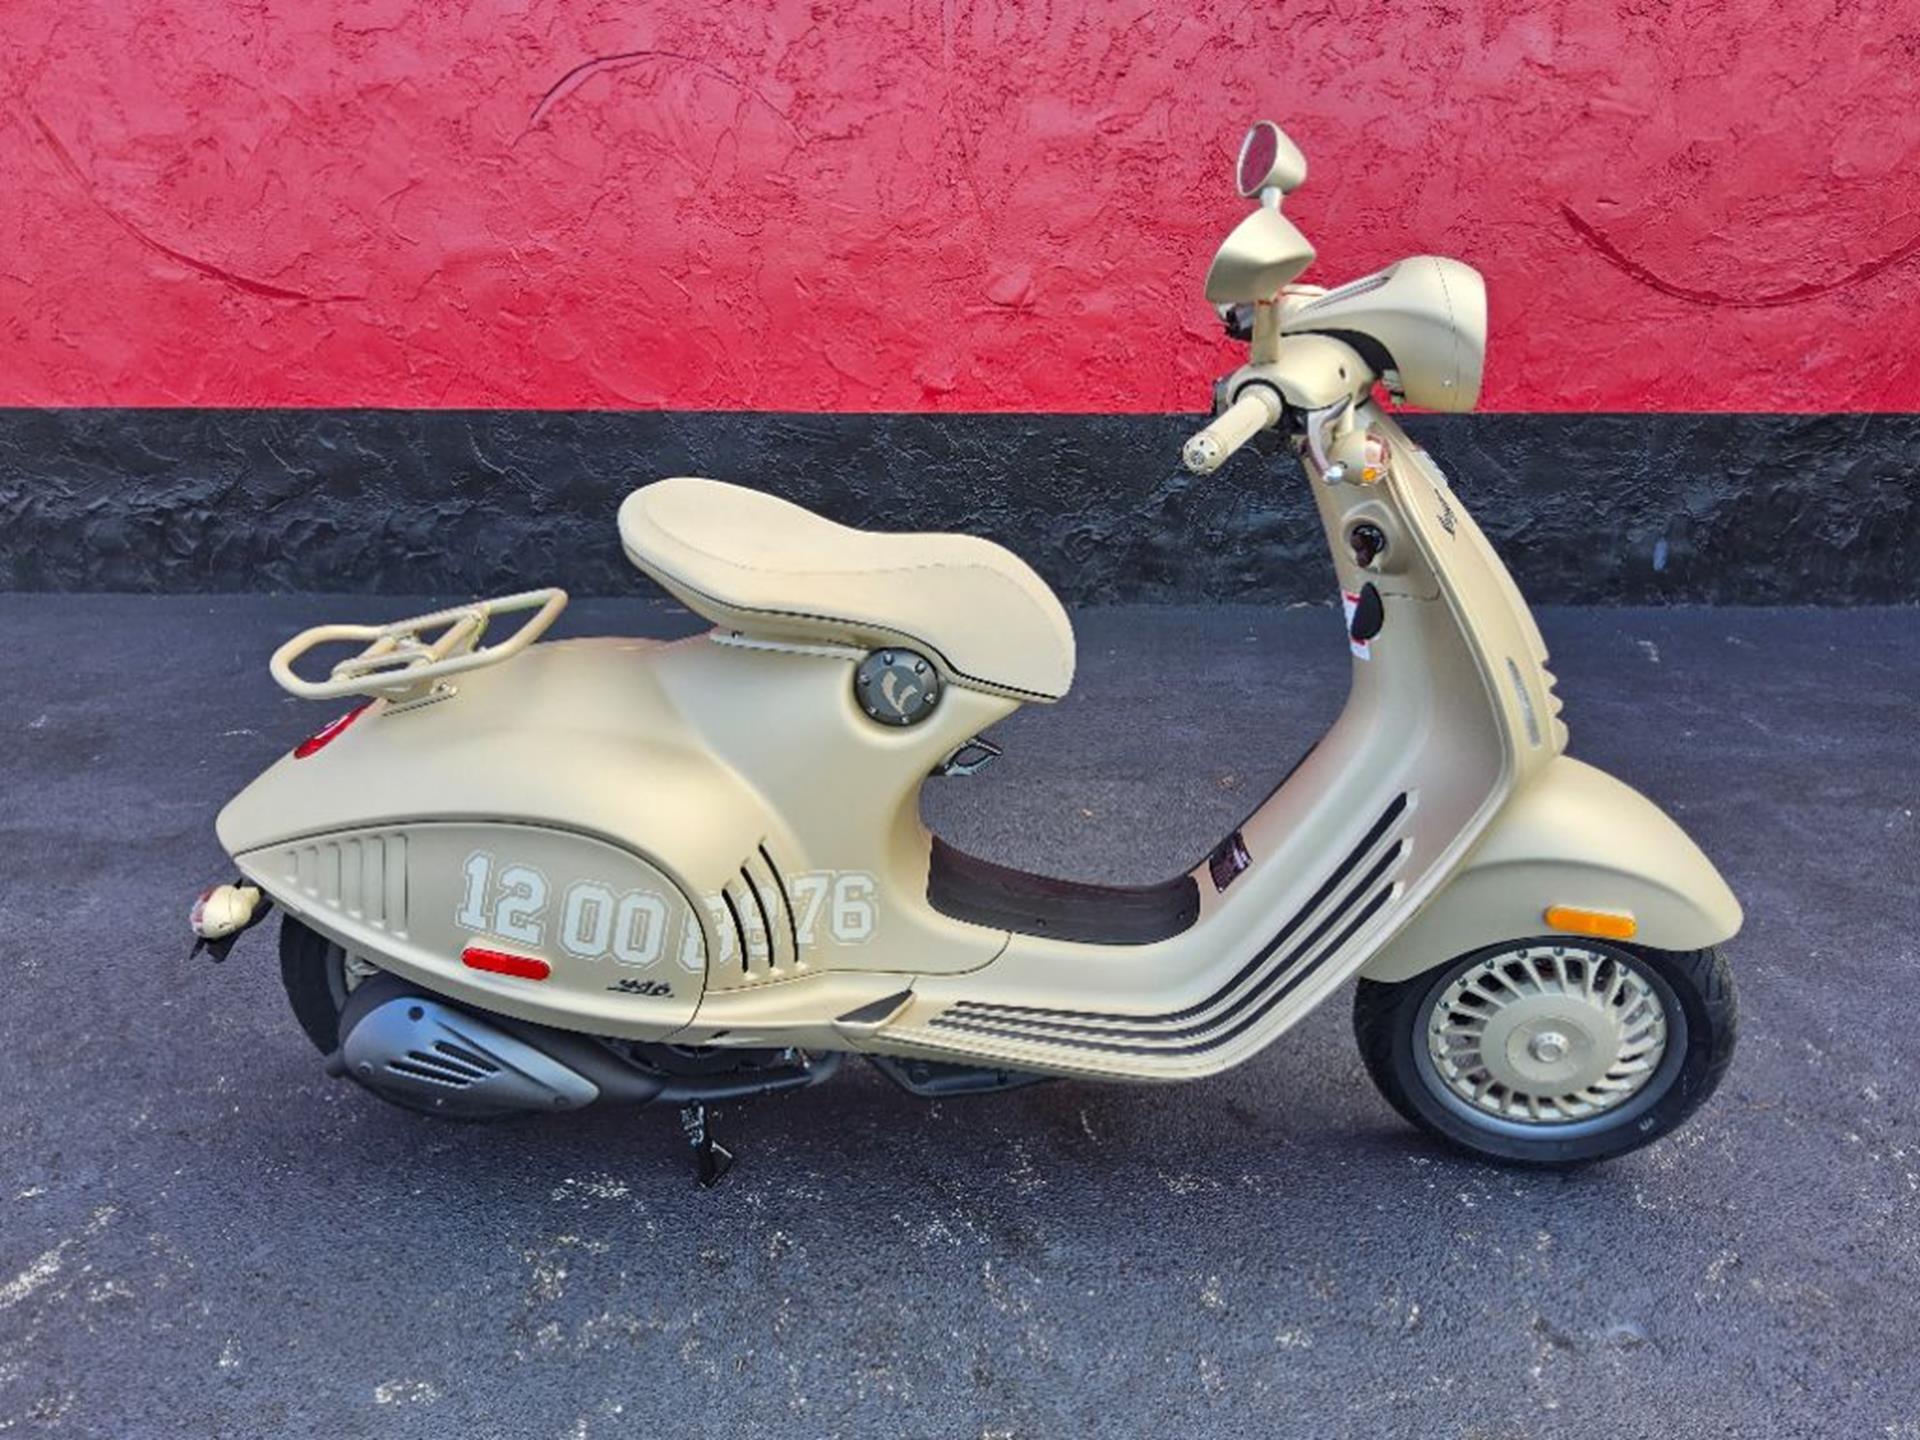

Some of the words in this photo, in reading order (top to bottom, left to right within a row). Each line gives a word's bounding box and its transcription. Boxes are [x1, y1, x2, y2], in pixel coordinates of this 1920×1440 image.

[456, 850, 551, 949] 12
[558, 879, 671, 969] 00
[787, 869, 880, 948] 76
